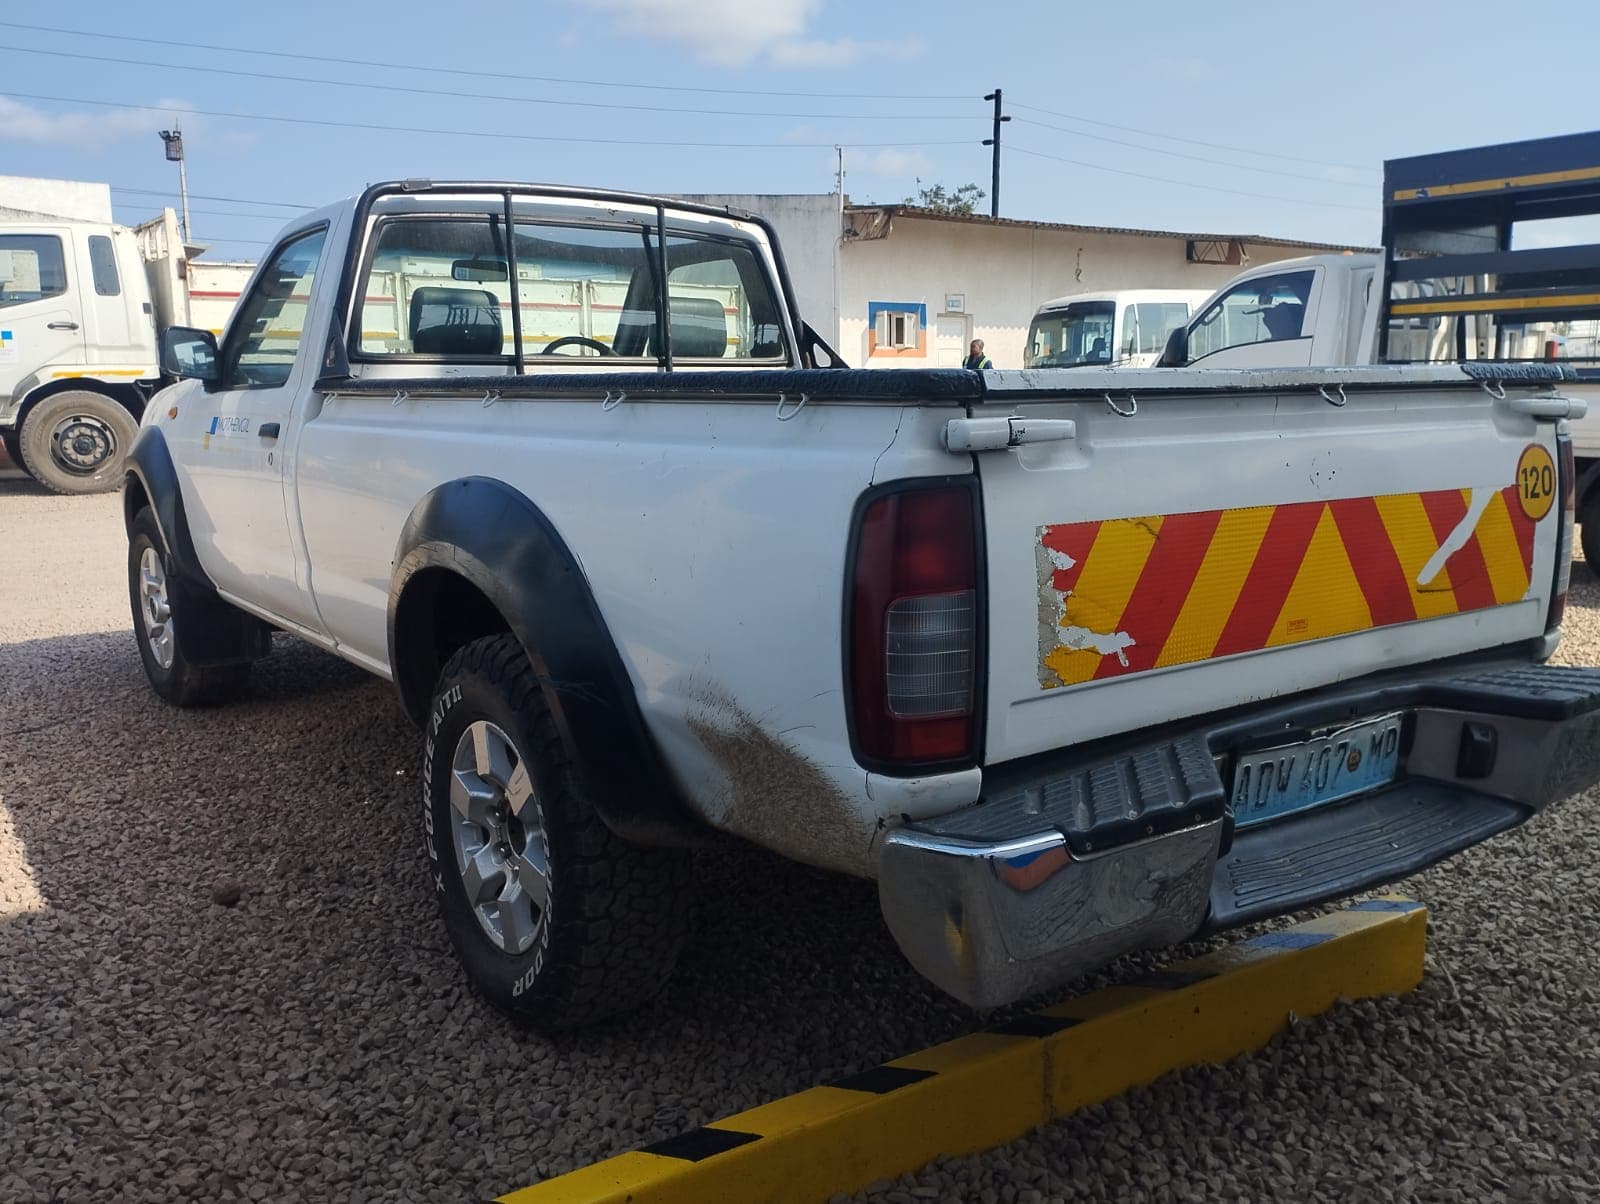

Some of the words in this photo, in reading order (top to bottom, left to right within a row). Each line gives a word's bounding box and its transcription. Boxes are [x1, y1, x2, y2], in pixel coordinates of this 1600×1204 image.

[1521, 465, 1553, 499] 120
[1301, 739, 1350, 795] 407
[424, 735, 438, 861] FORCE
